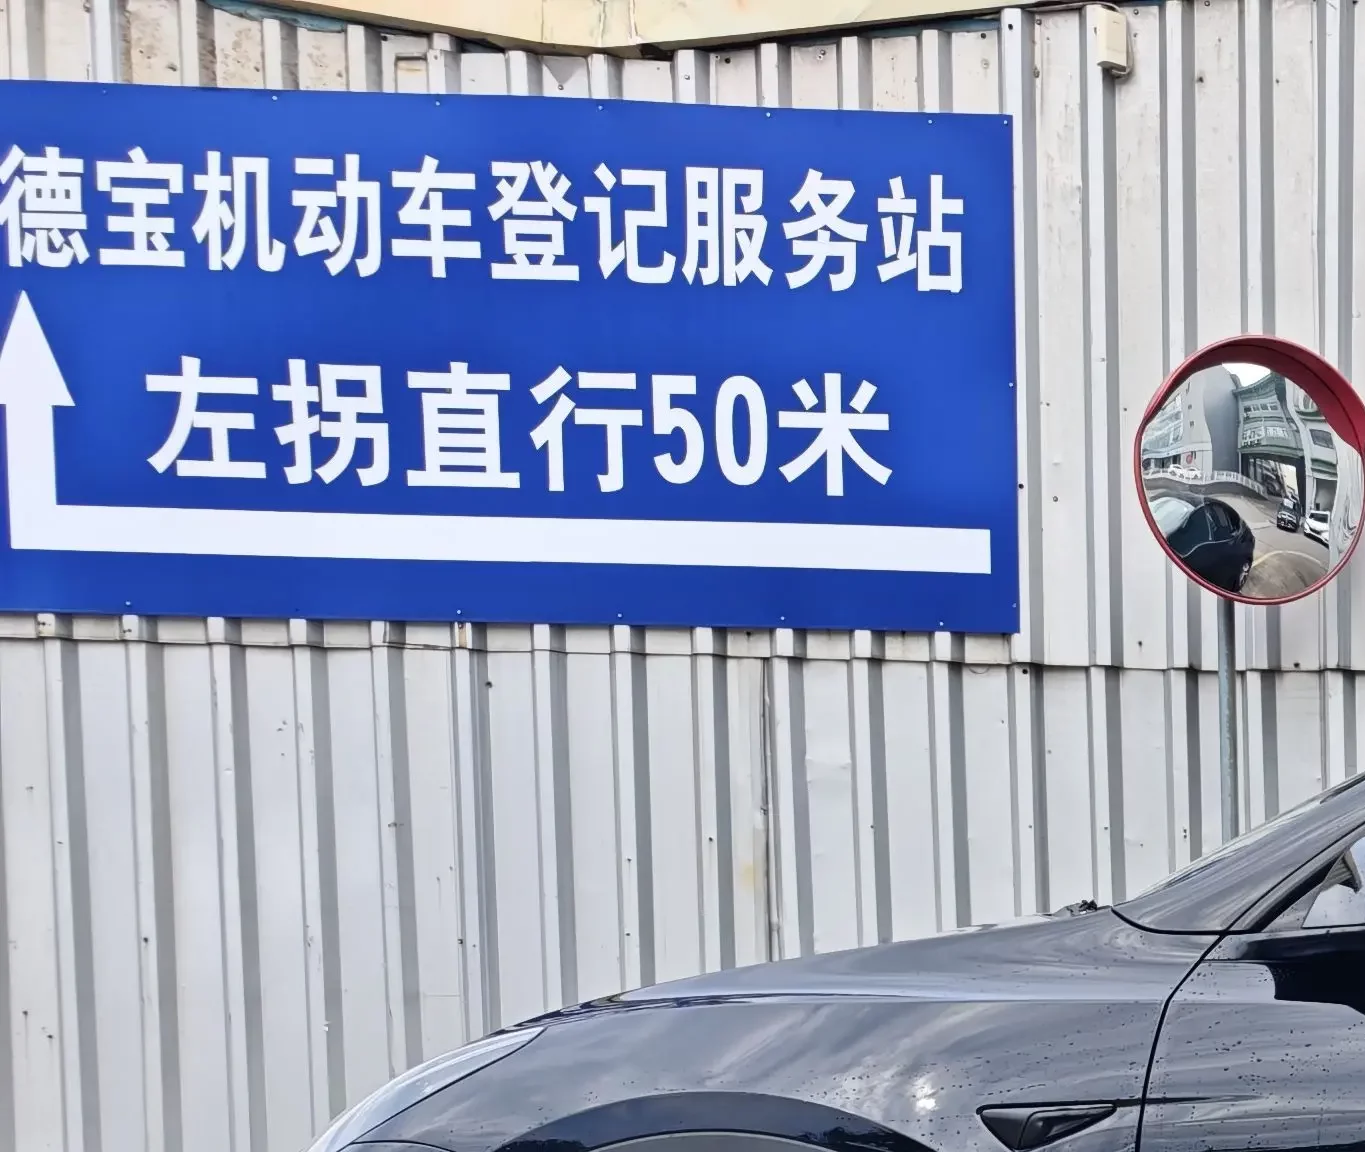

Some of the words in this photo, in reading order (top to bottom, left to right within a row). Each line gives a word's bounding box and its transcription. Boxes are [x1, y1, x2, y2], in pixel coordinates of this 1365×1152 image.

[0, 145, 965, 294] 德宝机动车登记服务站
[146, 355, 894, 497] 左拐直行50米
